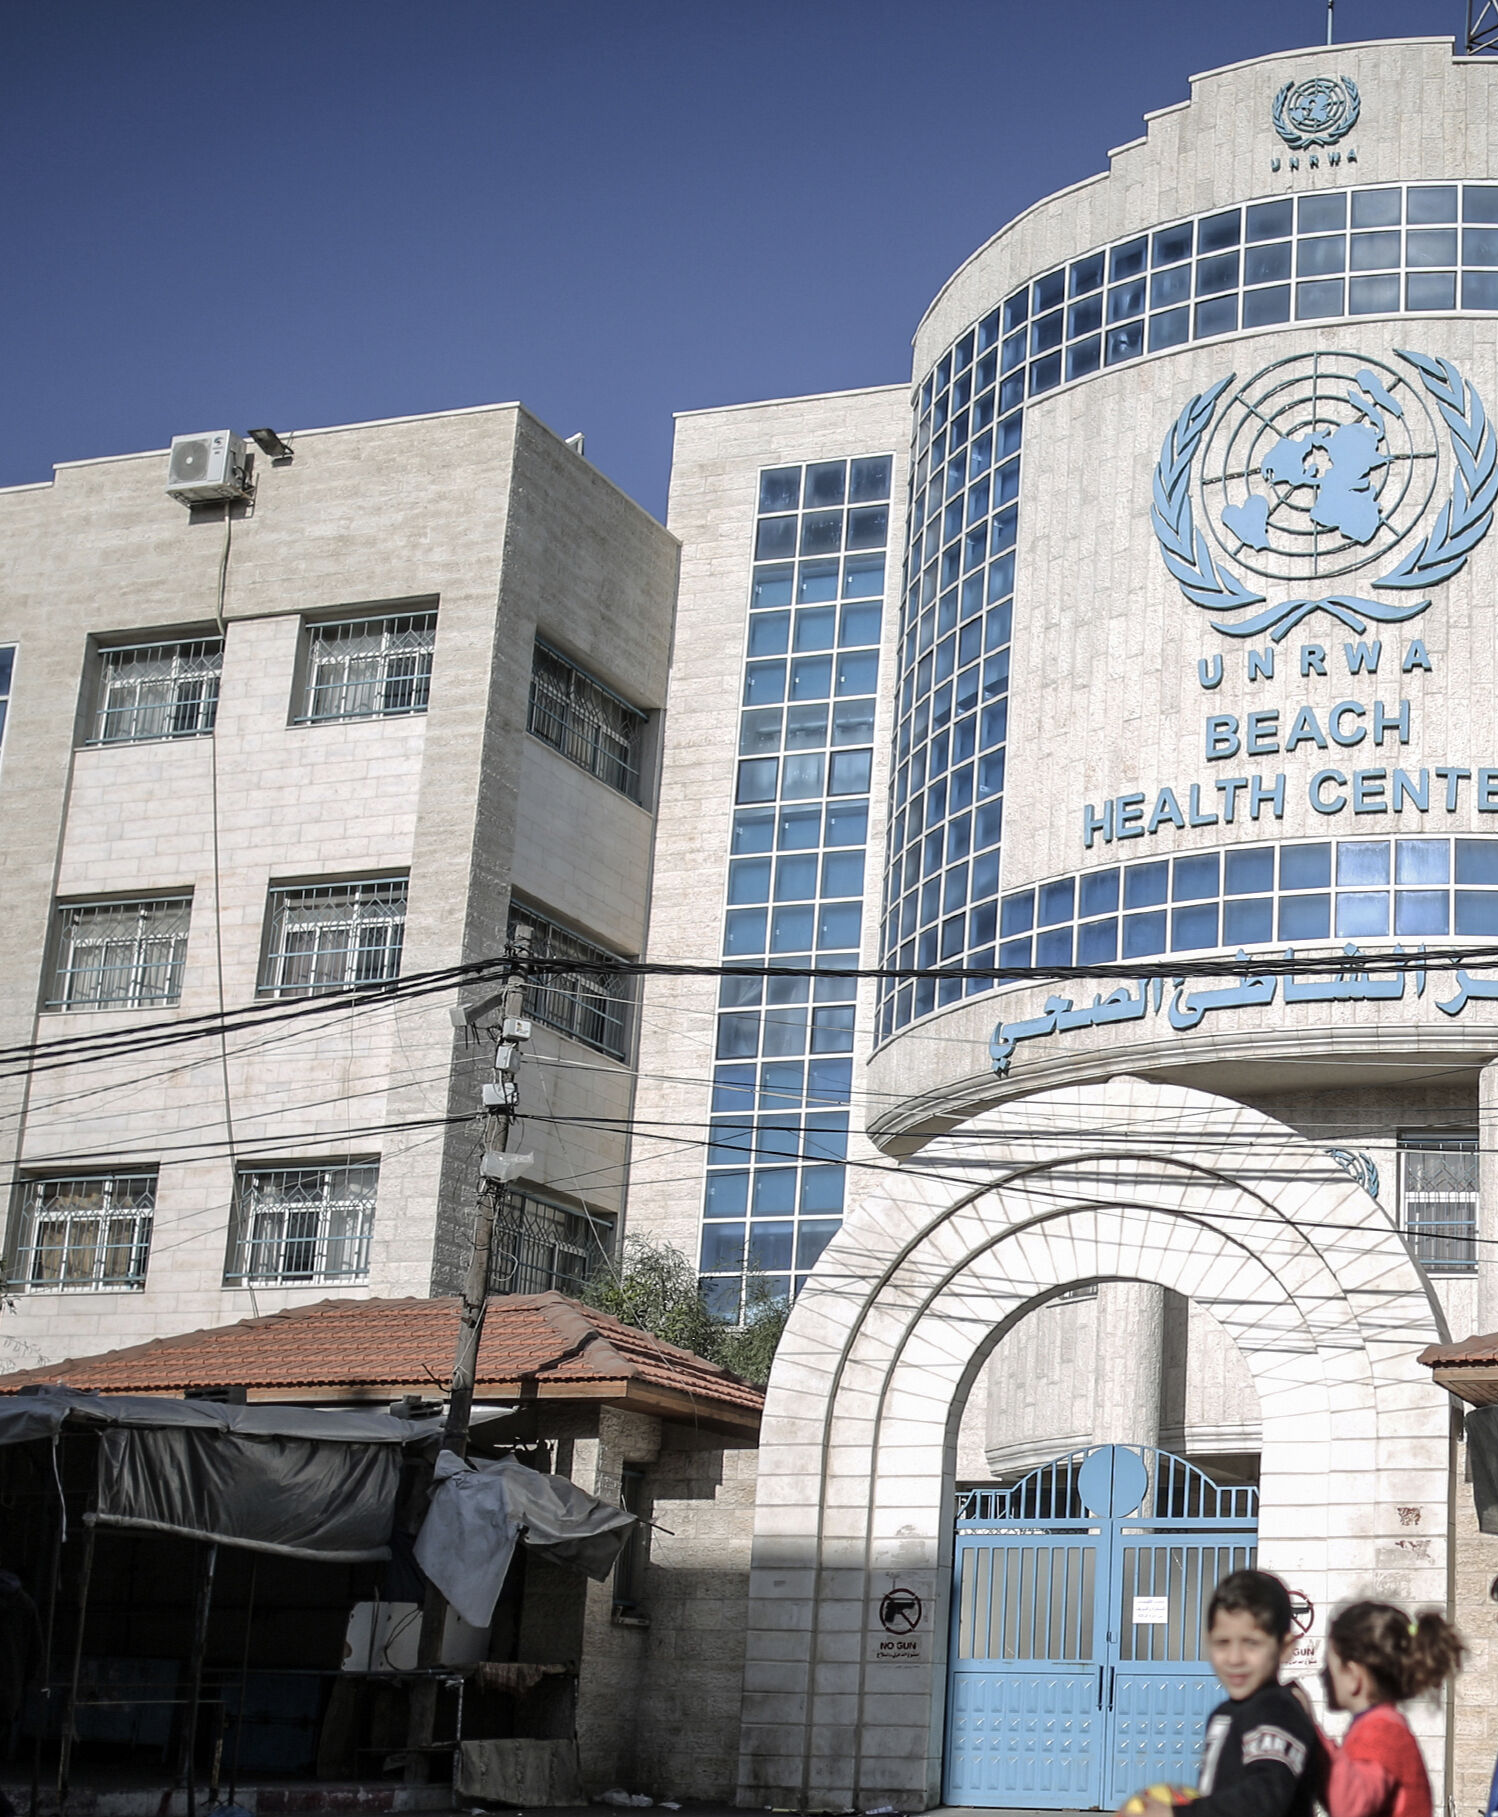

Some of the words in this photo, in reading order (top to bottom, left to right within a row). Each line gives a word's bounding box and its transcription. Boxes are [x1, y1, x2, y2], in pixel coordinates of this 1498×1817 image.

[1270, 148, 1358, 173] UNRWA
[1197, 638, 1433, 690] UNRWA
[1205, 699, 1411, 762] BEACH
[1083, 773, 1286, 848] HEALTH
[988, 961, 1165, 1077] الصحي
[880, 1641, 895, 1650] NO
[896, 1641, 917, 1650] GUN
[1293, 1647, 1315, 1656] GUN
